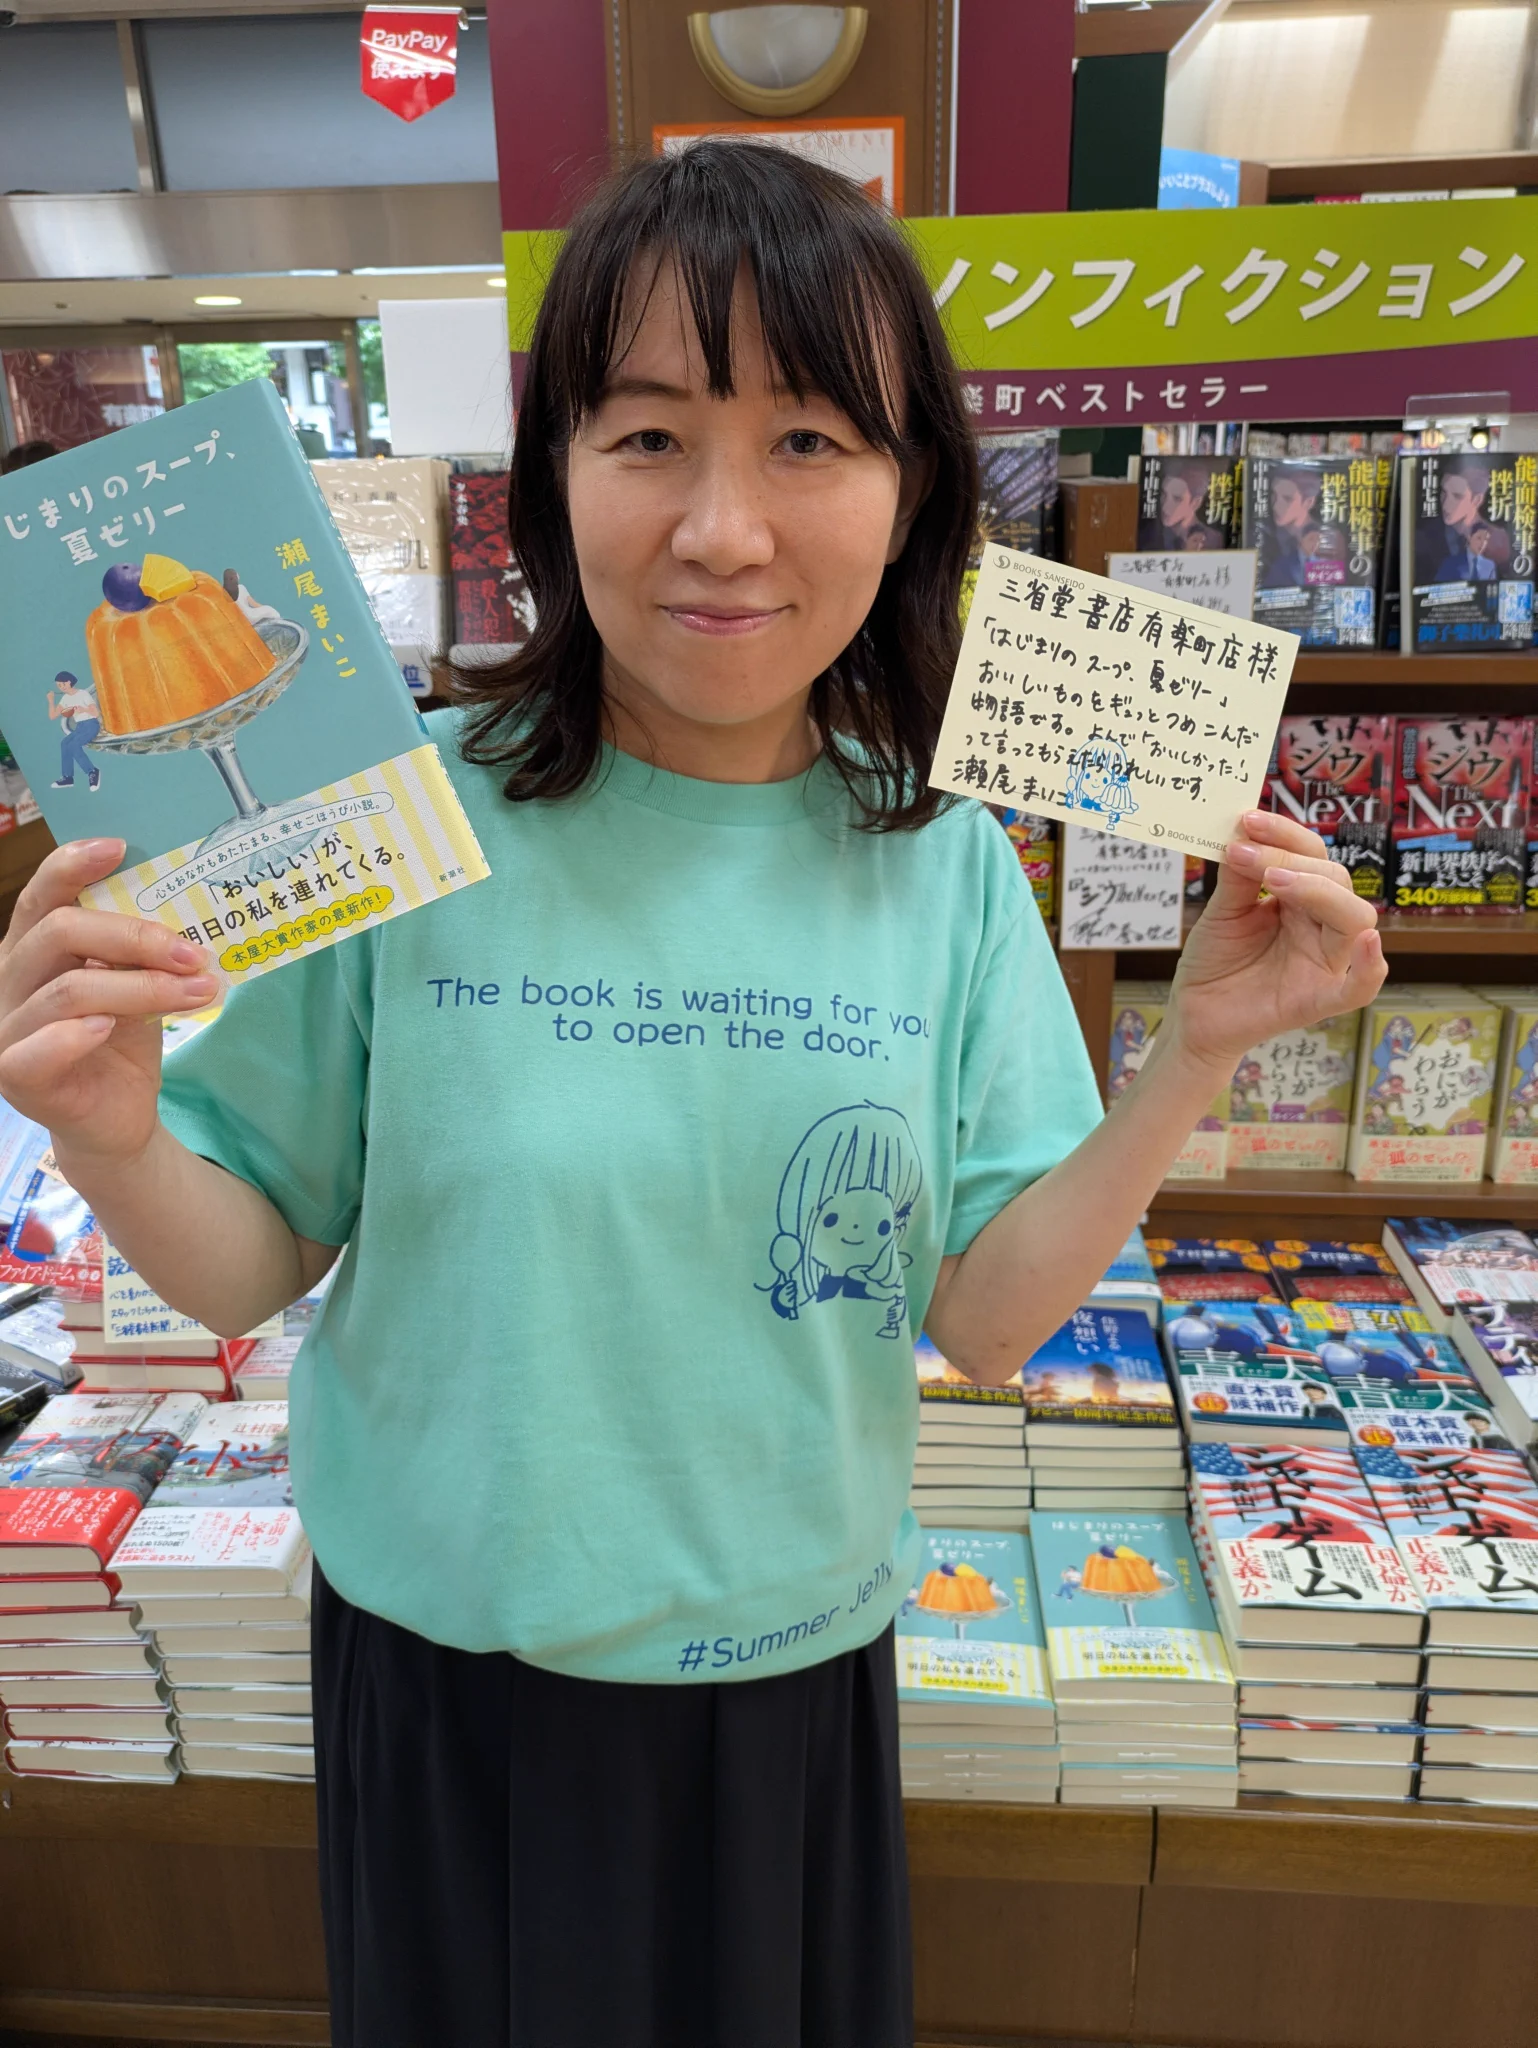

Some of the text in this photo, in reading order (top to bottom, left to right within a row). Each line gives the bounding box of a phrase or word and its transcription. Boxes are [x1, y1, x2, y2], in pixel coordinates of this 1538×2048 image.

[371, 28, 448, 53] PayPay
[932, 245, 1526, 332] ノンフィクション
[60, 502, 186, 566] 夏ゼリー
[1012, 561, 1042, 580] BOOKS
[275, 538, 357, 678] 瀬尾まいこ
[998, 577, 1279, 684] 三省堂書店有楽町店様
[1167, 829, 1196, 843] BOOKS
[1404, 784, 1521, 829] Next
[155, 799, 381, 901] 心もおなかもあたたまる、幸せごほうび小説。
[208, 831, 354, 905] 「おいしい」が、
[438, 866, 467, 883] 新潮社
[178, 846, 406, 947] 明日の私を連れてくる。
[427, 977, 501, 1008] The
[521, 975, 616, 1009] book
[633, 981, 663, 1010] is
[682, 986, 813, 1020] waiting
[830, 994, 878, 1026] for
[553, 1013, 891, 1062] to open the door.
[678, 1558, 894, 1672] #Summer Jelly
